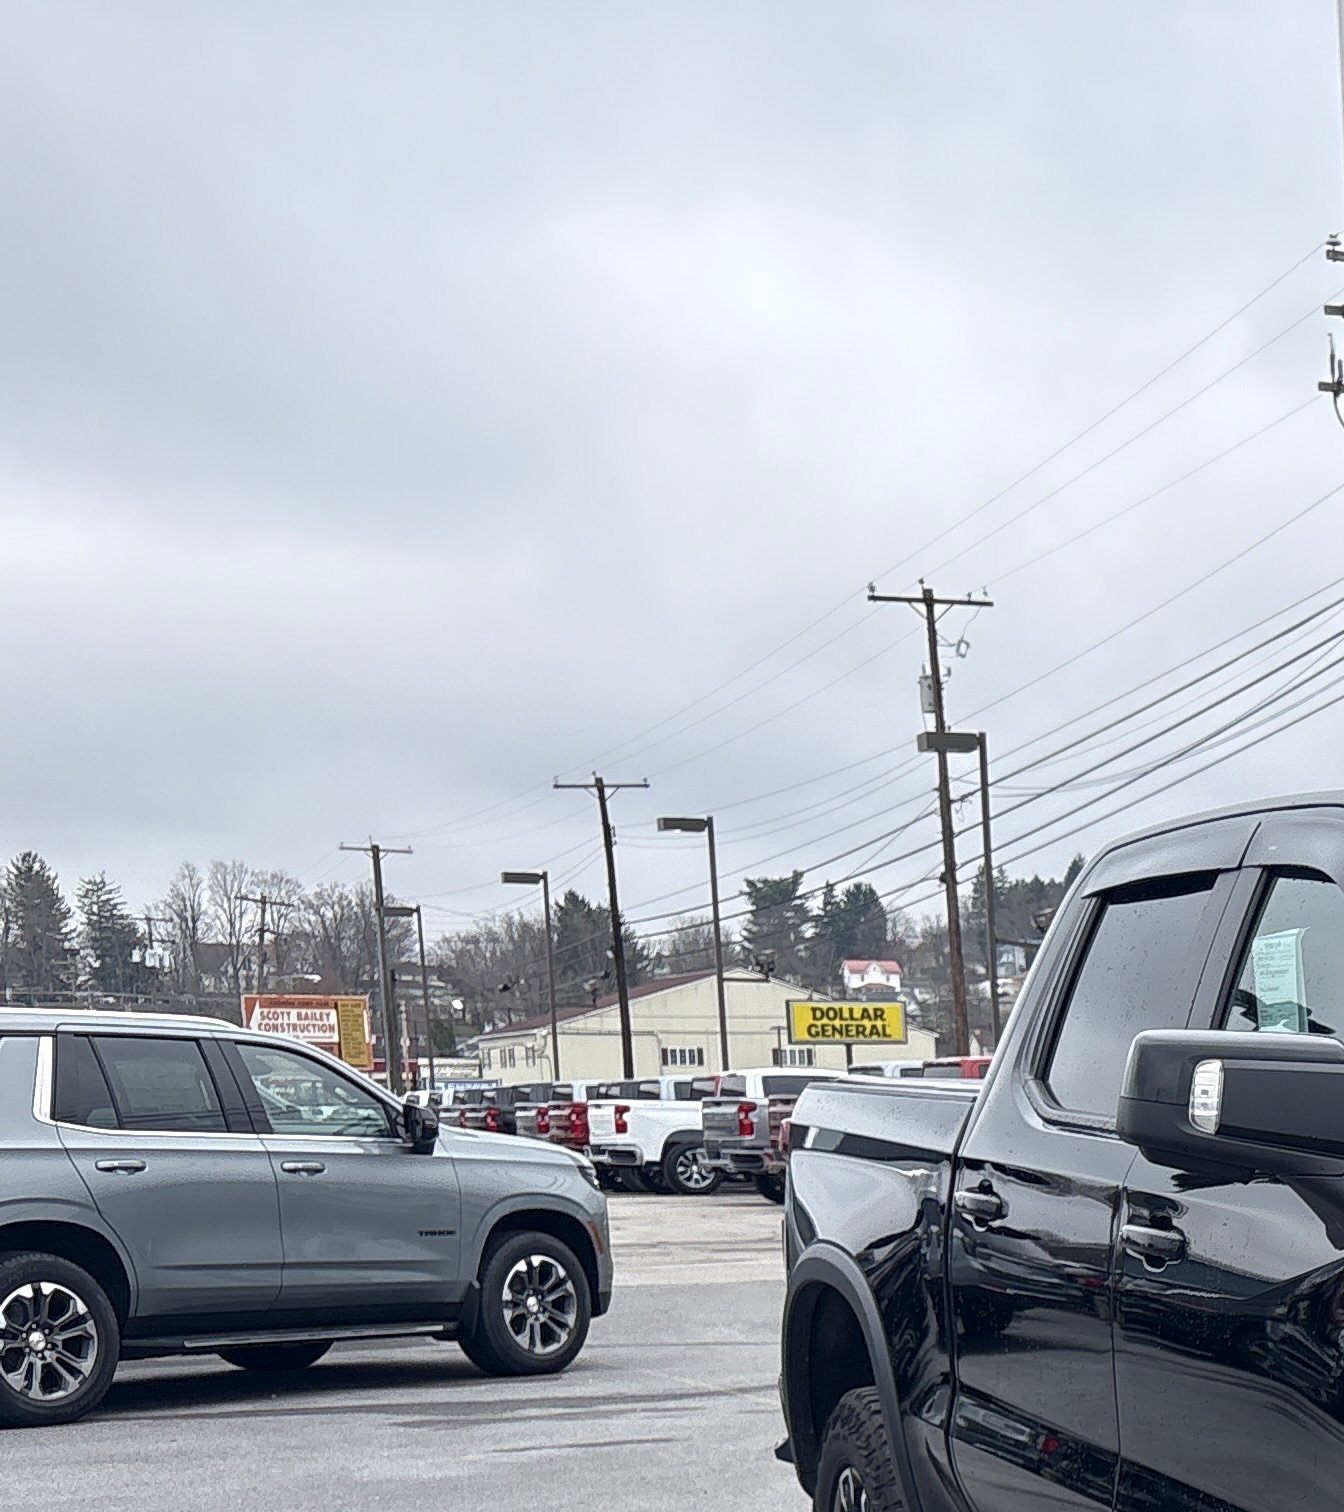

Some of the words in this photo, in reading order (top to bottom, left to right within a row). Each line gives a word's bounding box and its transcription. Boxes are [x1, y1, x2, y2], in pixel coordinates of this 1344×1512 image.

[259, 1010, 291, 1021] SCOTT
[296, 1011, 331, 1022] BAILEY
[810, 1006, 887, 1022] DOLLAR
[257, 1022, 335, 1034] CONSTRUCTION
[807, 1023, 893, 1039] GENERAL
